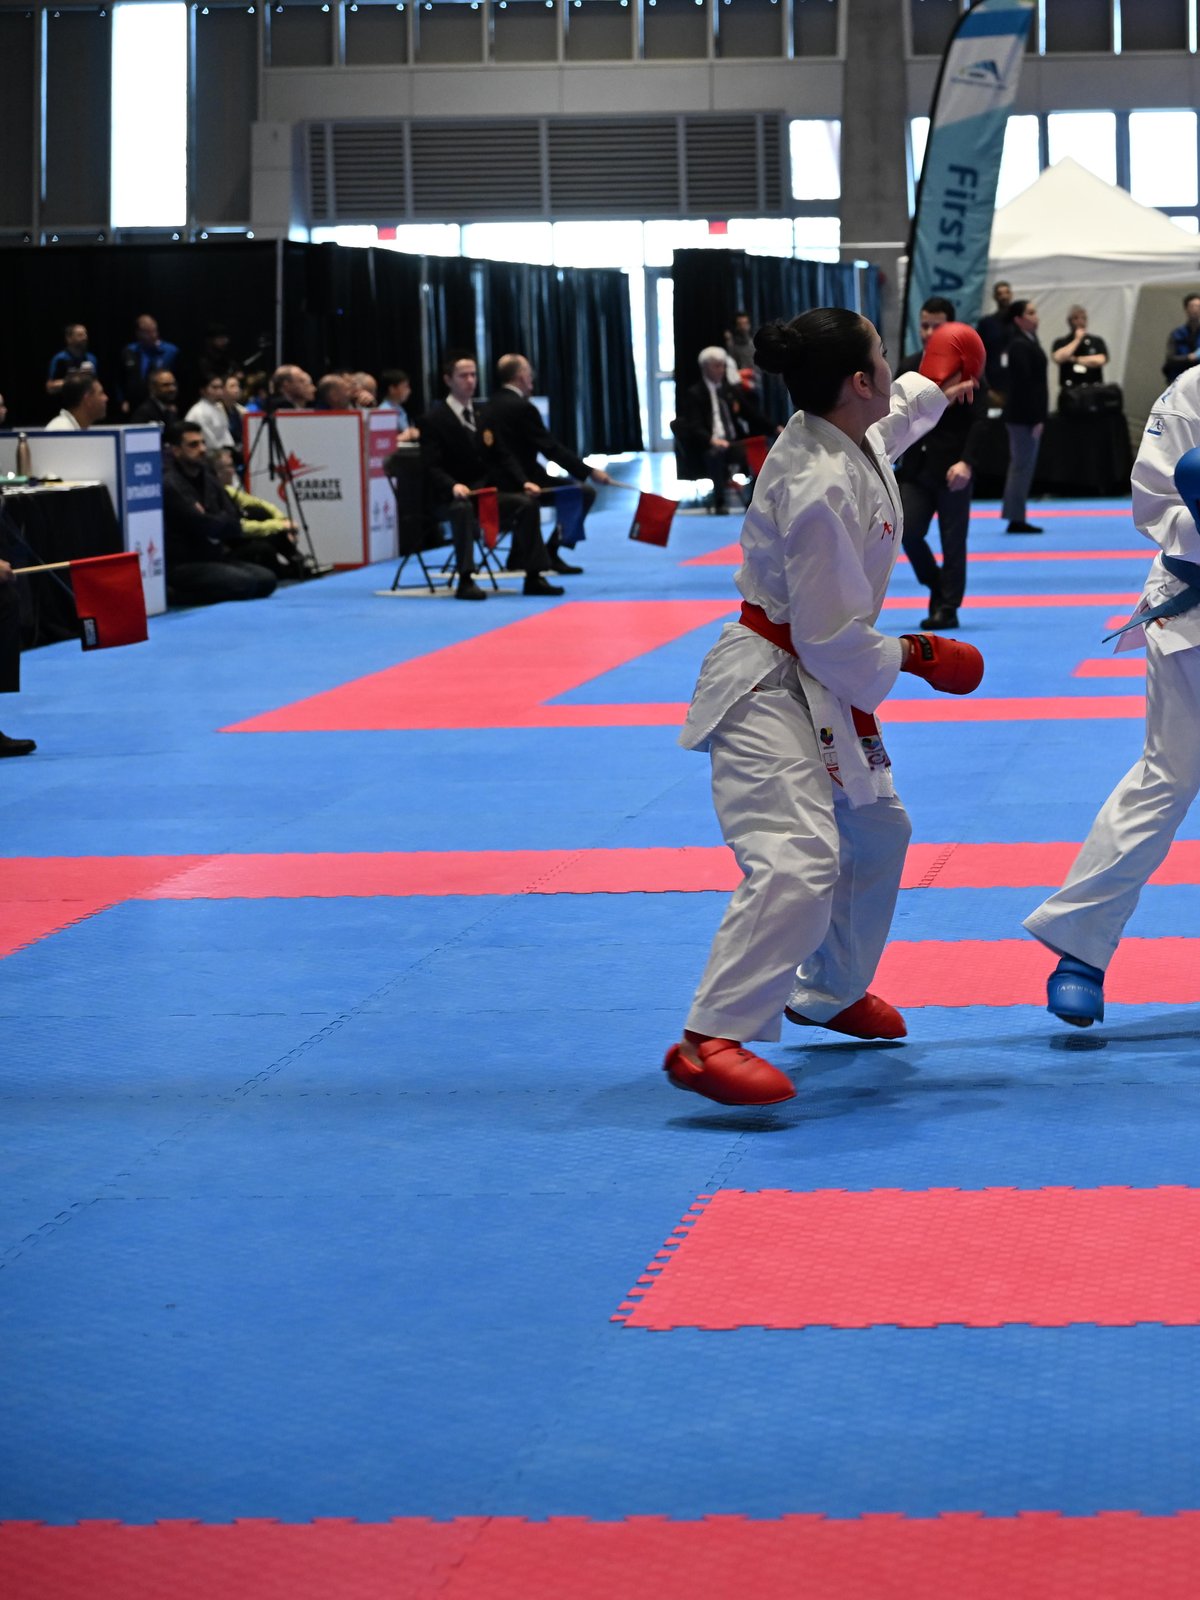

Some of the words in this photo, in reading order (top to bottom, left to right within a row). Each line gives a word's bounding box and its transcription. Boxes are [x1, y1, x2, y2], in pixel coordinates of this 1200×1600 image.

[937, 162, 978, 255] First
[295, 478, 341, 490] KARATE
[296, 490, 343, 501] CANADA
